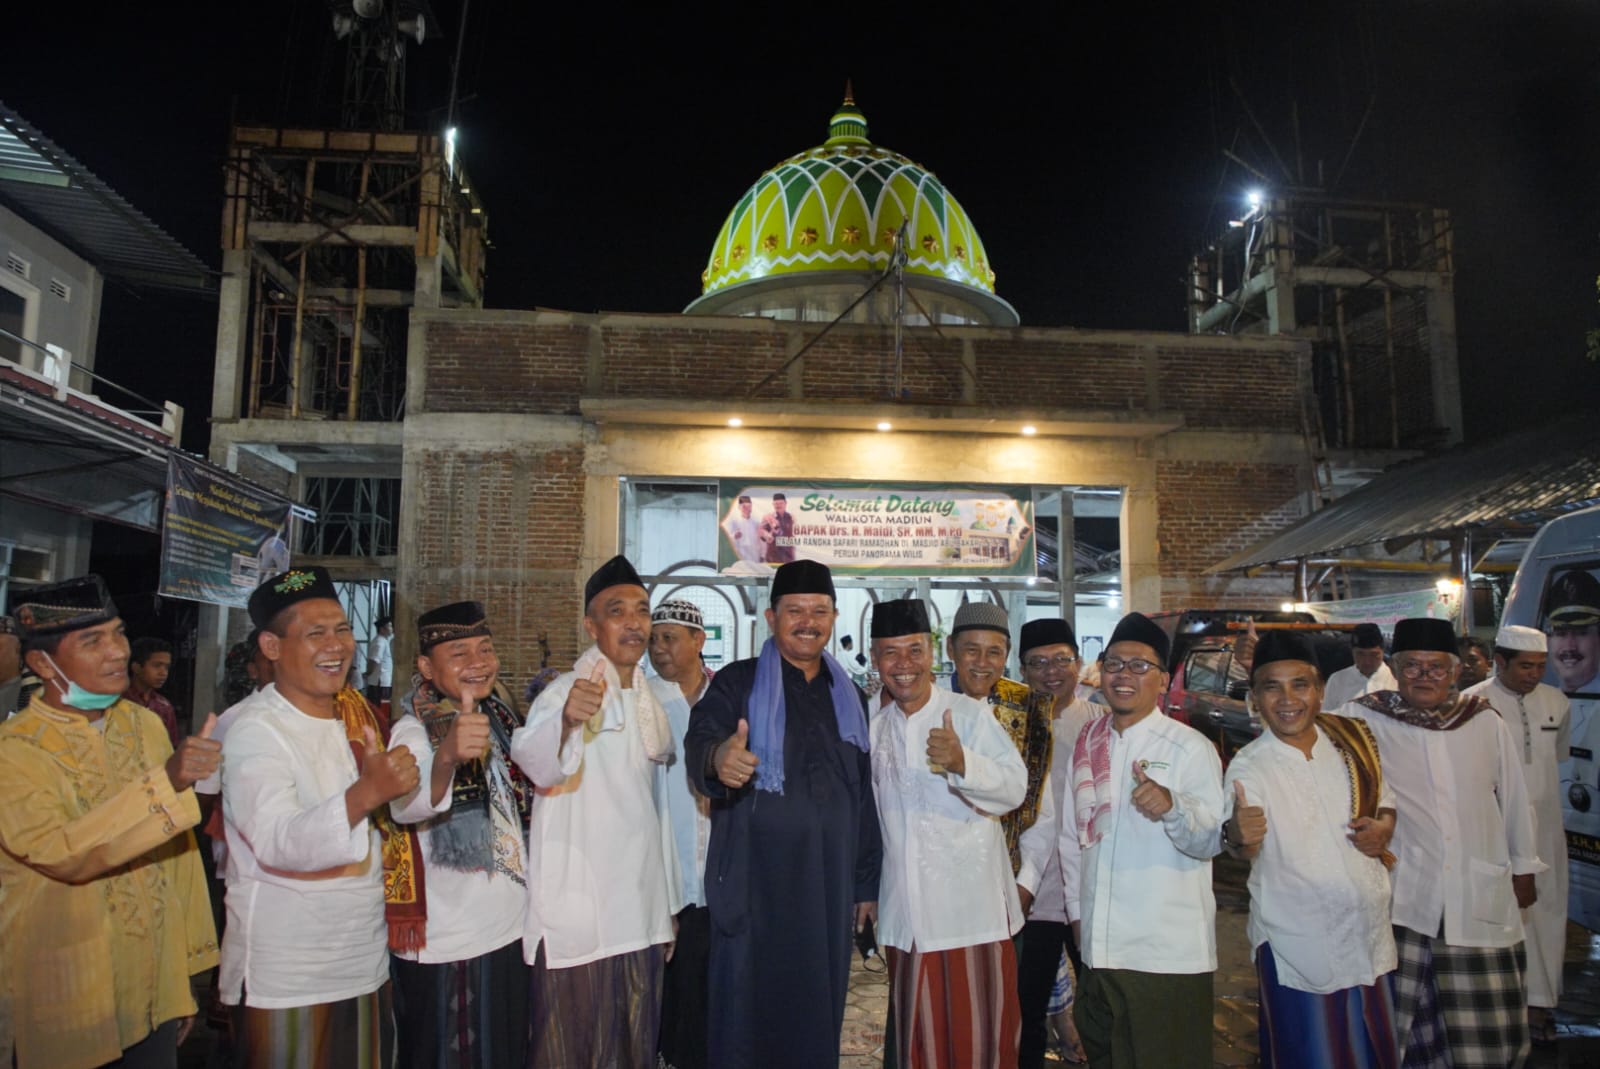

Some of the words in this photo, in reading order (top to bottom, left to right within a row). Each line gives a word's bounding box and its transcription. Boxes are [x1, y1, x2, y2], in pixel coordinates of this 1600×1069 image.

[800, 493, 882, 511] Selamat
[885, 494, 955, 517] Datang
[825, 514, 882, 524] WALIKOTA
[886, 515, 932, 525] MADIUN
[793, 525, 827, 536] BAPAK
[829, 526, 849, 537] Drs.
[776, 537, 801, 546] DALAM
[803, 538, 831, 546] RANGKA
[833, 538, 858, 547] SAFARI
[860, 538, 899, 548] RAMADHAN
[912, 539, 938, 548] MASJID
[834, 550, 859, 558] PERUM
[861, 550, 900, 559] PANORAMA
[901, 550, 923, 559] WILIS
